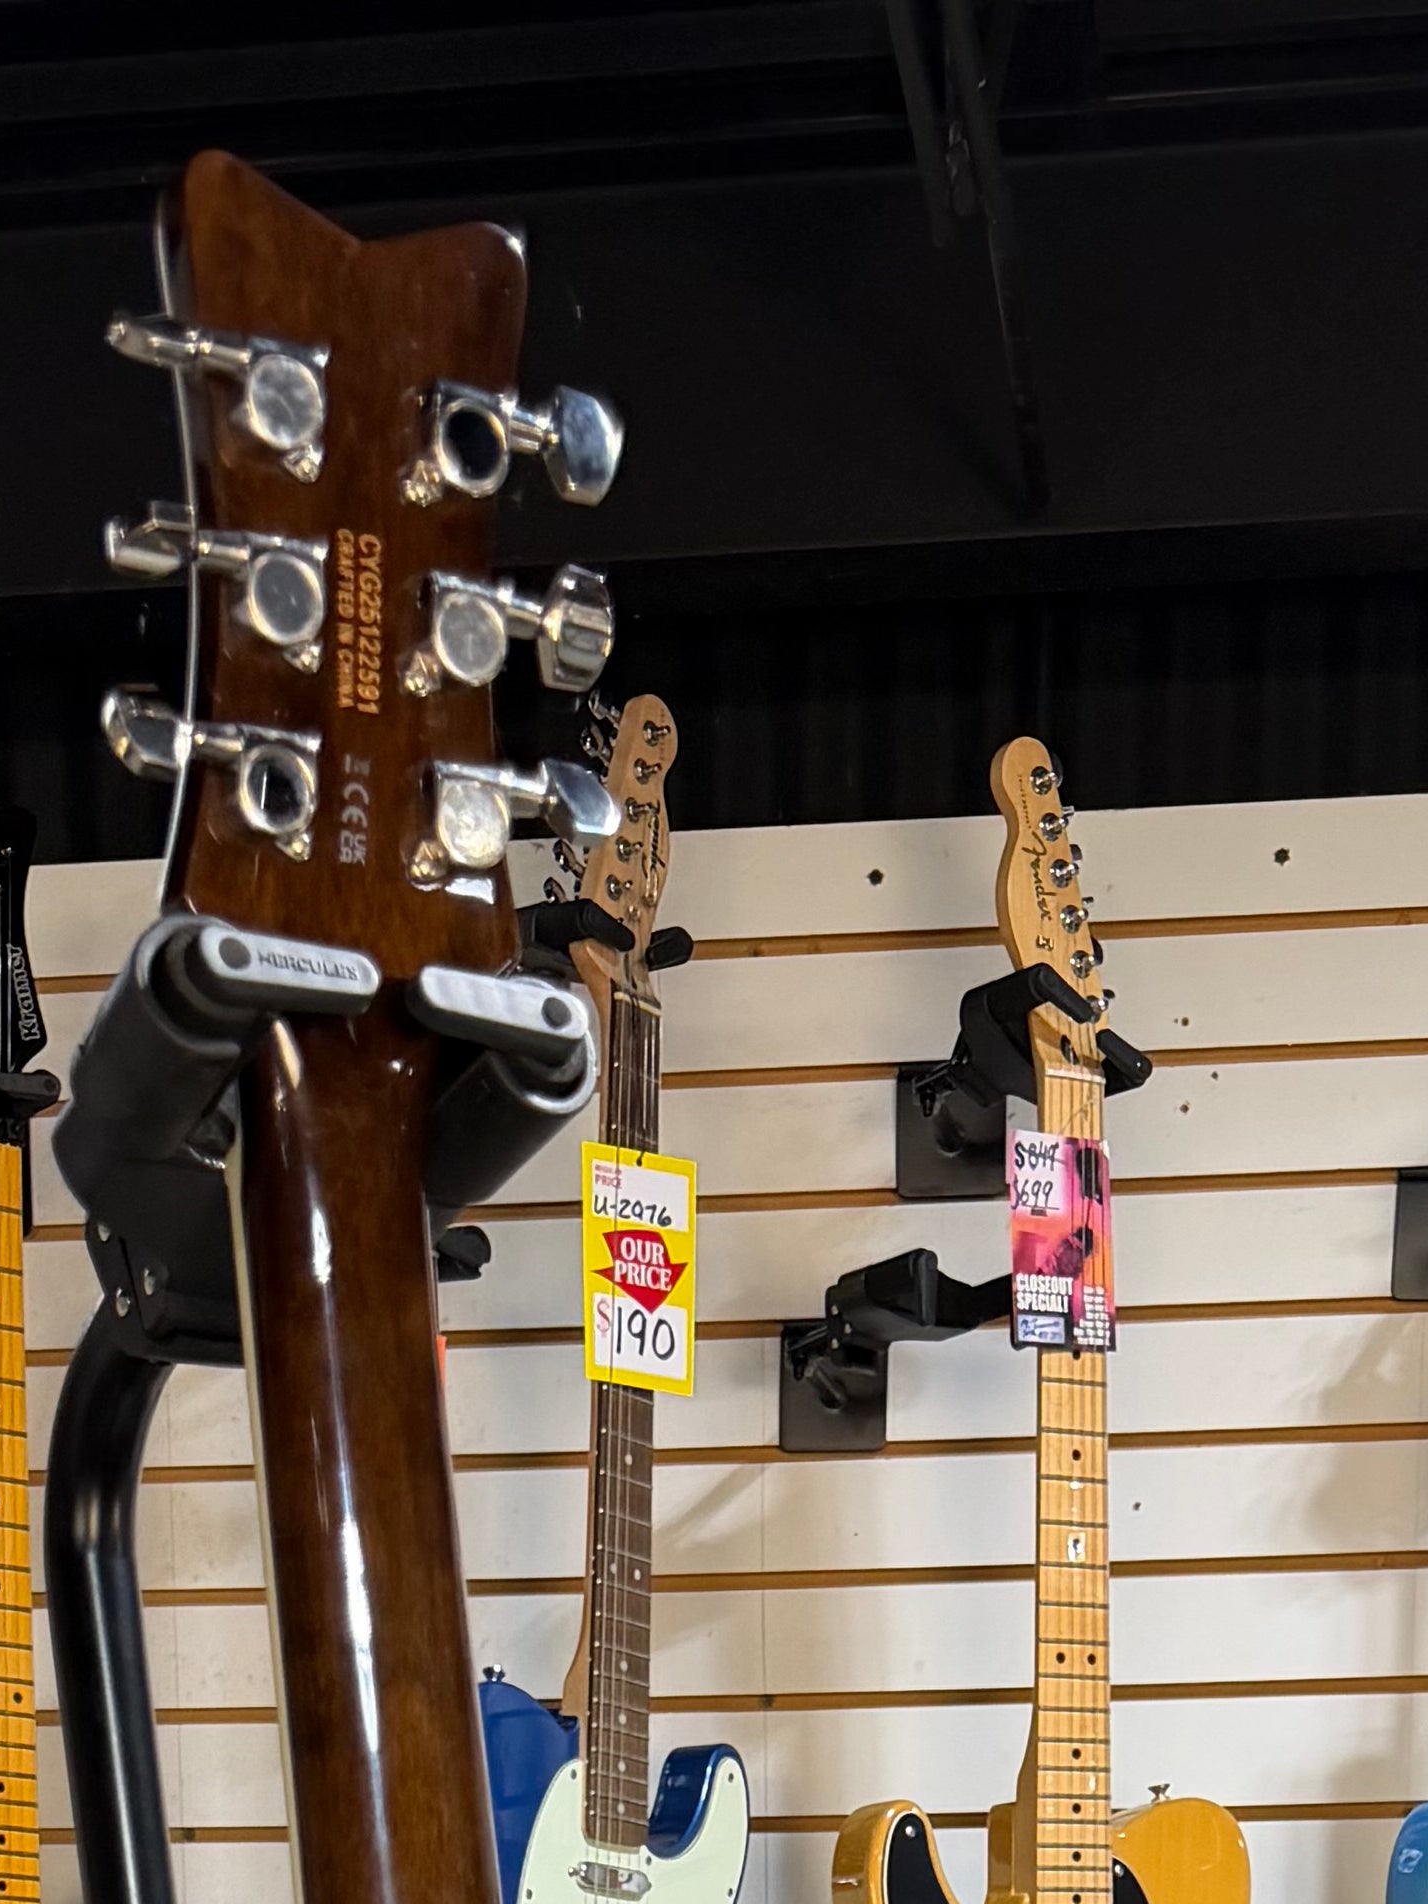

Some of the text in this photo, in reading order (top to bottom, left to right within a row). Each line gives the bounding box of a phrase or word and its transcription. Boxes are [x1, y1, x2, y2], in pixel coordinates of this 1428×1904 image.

[336, 528, 356, 709] CRAFTED IN CHINA
[1021, 831, 1057, 923] Fender
[258, 950, 359, 981] HERCULES
[6, 943, 41, 1041] Kramer
[594, 1173, 623, 1190] PRICE
[1011, 1174, 1055, 1210] $699
[620, 1236, 666, 1266] OUR
[613, 1260, 673, 1292] PRICE
[1016, 1274, 1074, 1296] CLOSEOUT
[1016, 1293, 1070, 1313] SPECIAL!
[595, 1298, 676, 1362] $190
